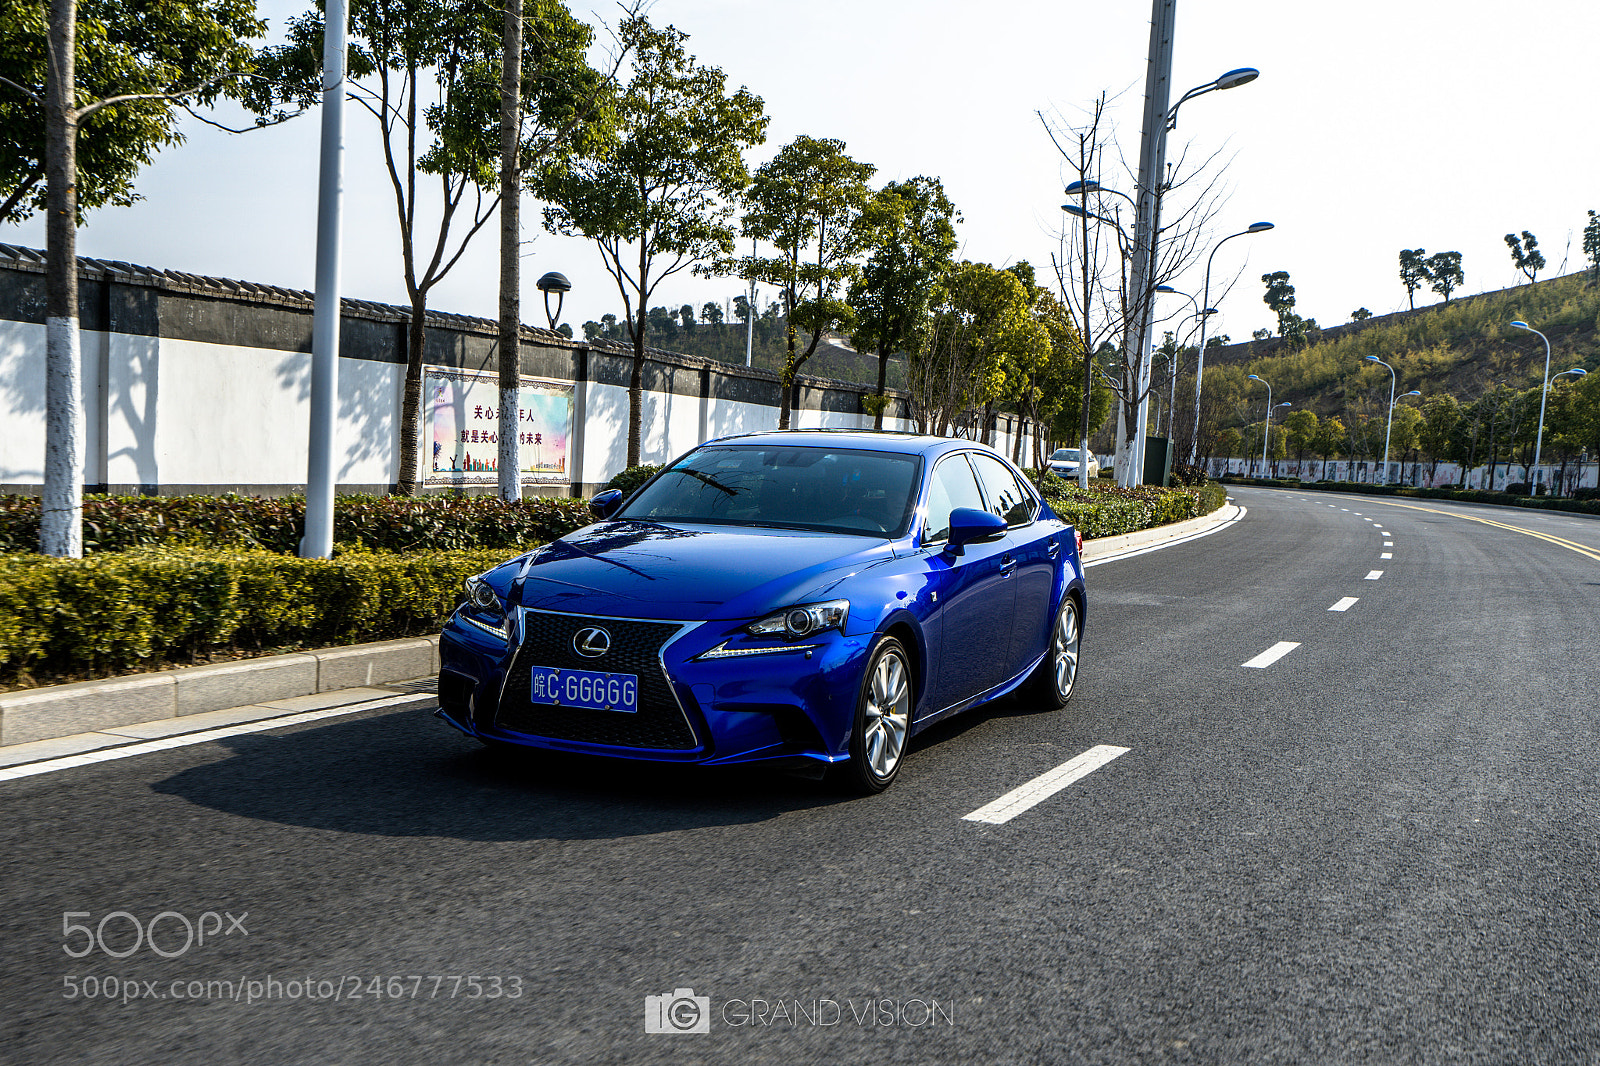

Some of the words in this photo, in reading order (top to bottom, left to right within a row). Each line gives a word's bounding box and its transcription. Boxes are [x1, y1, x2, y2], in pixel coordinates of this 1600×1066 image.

[461, 430, 542, 445] 就是关心的未来
